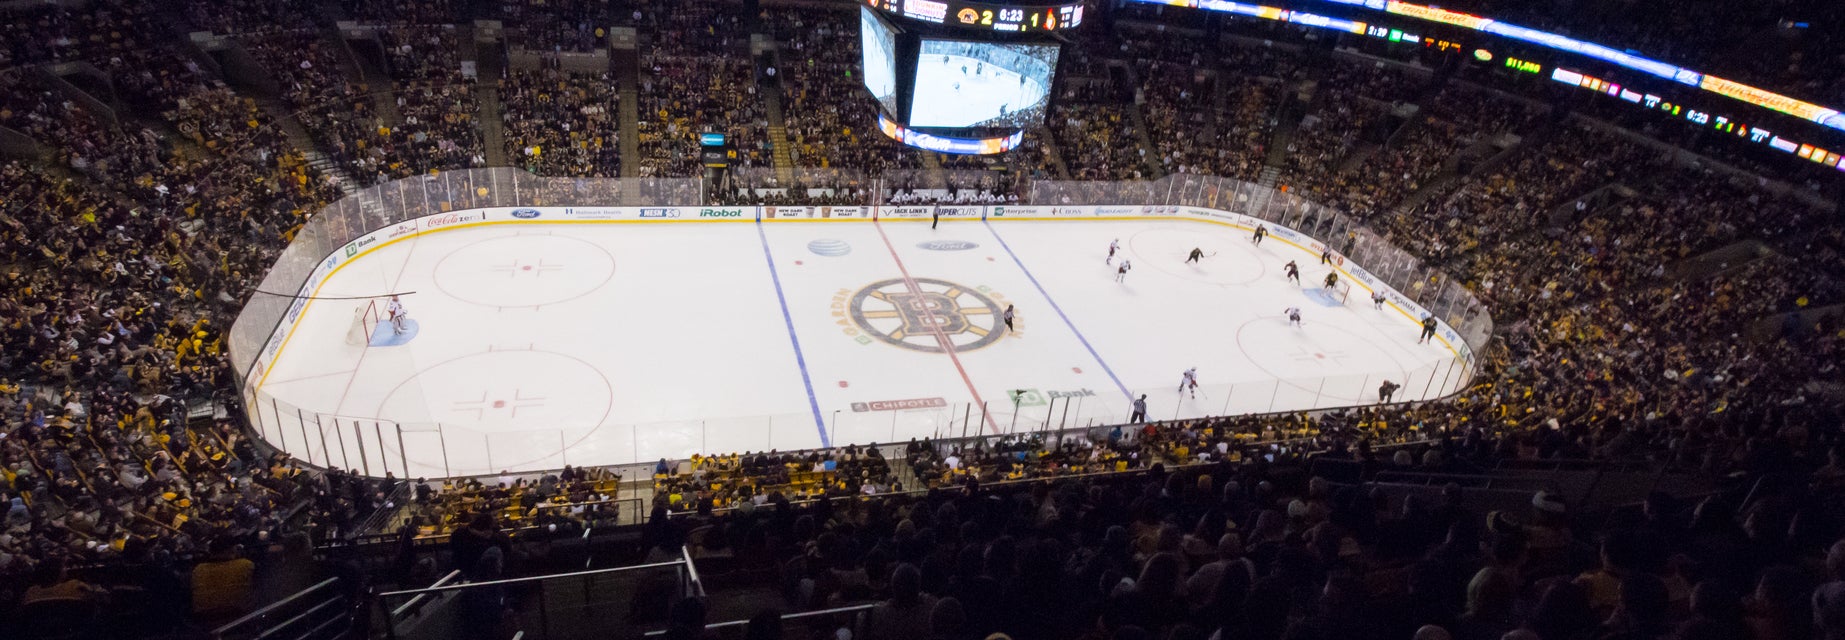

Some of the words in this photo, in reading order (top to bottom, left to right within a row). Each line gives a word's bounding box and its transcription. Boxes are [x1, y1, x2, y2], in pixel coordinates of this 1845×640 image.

[981, 10, 993, 25] 2
[1000, 9, 1023, 21] 6:23
[1031, 13, 1038, 27] 1
[994, 23, 1018, 31] PERIOD
[1687, 109, 1709, 124] 6:23
[516, 209, 535, 217] Ford
[643, 209, 663, 217] NESN
[700, 209, 742, 217] iRobot
[937, 208, 977, 216] UPERCUTS
[358, 236, 376, 248] Bank
[930, 241, 966, 249] Ford
[289, 287, 310, 324] GEICO
[1048, 388, 1096, 398] Bank
[872, 400, 945, 410] CHIPOTLE
